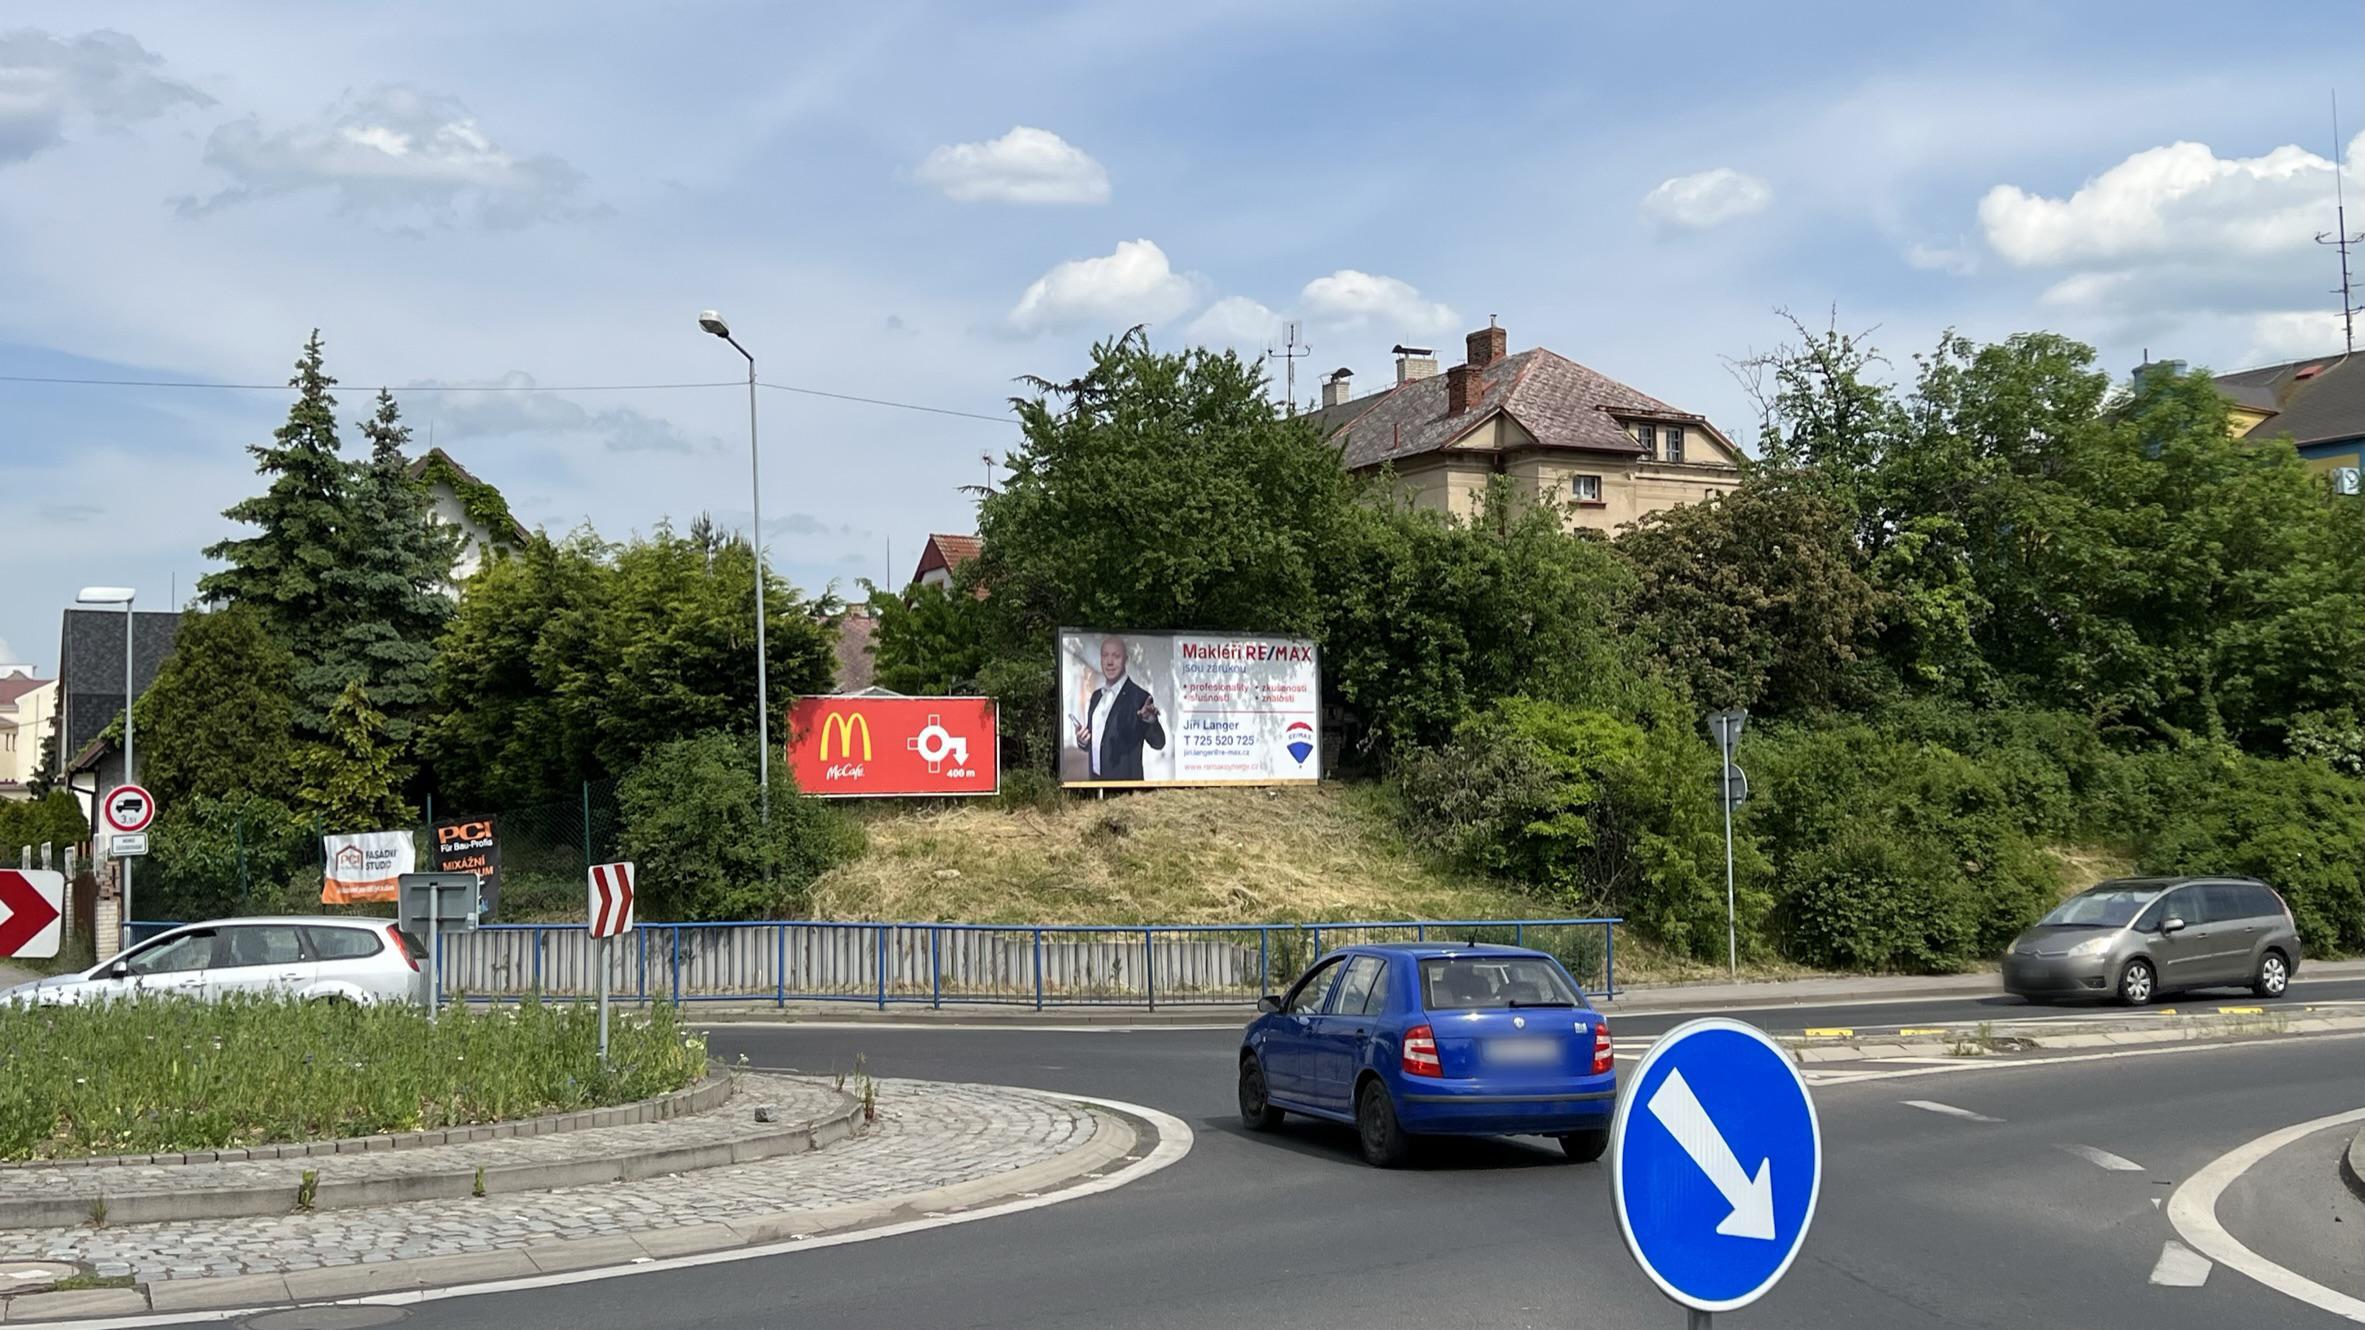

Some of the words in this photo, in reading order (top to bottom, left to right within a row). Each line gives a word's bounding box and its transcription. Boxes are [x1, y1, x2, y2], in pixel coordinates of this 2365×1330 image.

[1183, 643, 1241, 660] Makléři
[1246, 645, 1312, 662] RE/MAX
[1183, 663, 1204, 674] jsou
[1206, 663, 1247, 674] zárukou
[1190, 683, 1249, 693] profesionality
[1183, 719, 1201, 730] Jiří
[1203, 720, 1240, 732] Langer
[1184, 735, 1190, 745] T
[1194, 735, 1212, 746] 725
[1215, 735, 1234, 746] 520
[1237, 735, 1255, 746] 725
[826, 763, 865, 780] McCafé
[946, 769, 966, 778] 400
[966, 770, 976, 778] m
[438, 821, 492, 843] PCI
[440, 843, 453, 853] Für
[453, 839, 493, 851] Bau-Profis
[442, 854, 486, 871] MIXÁŽNÍ
